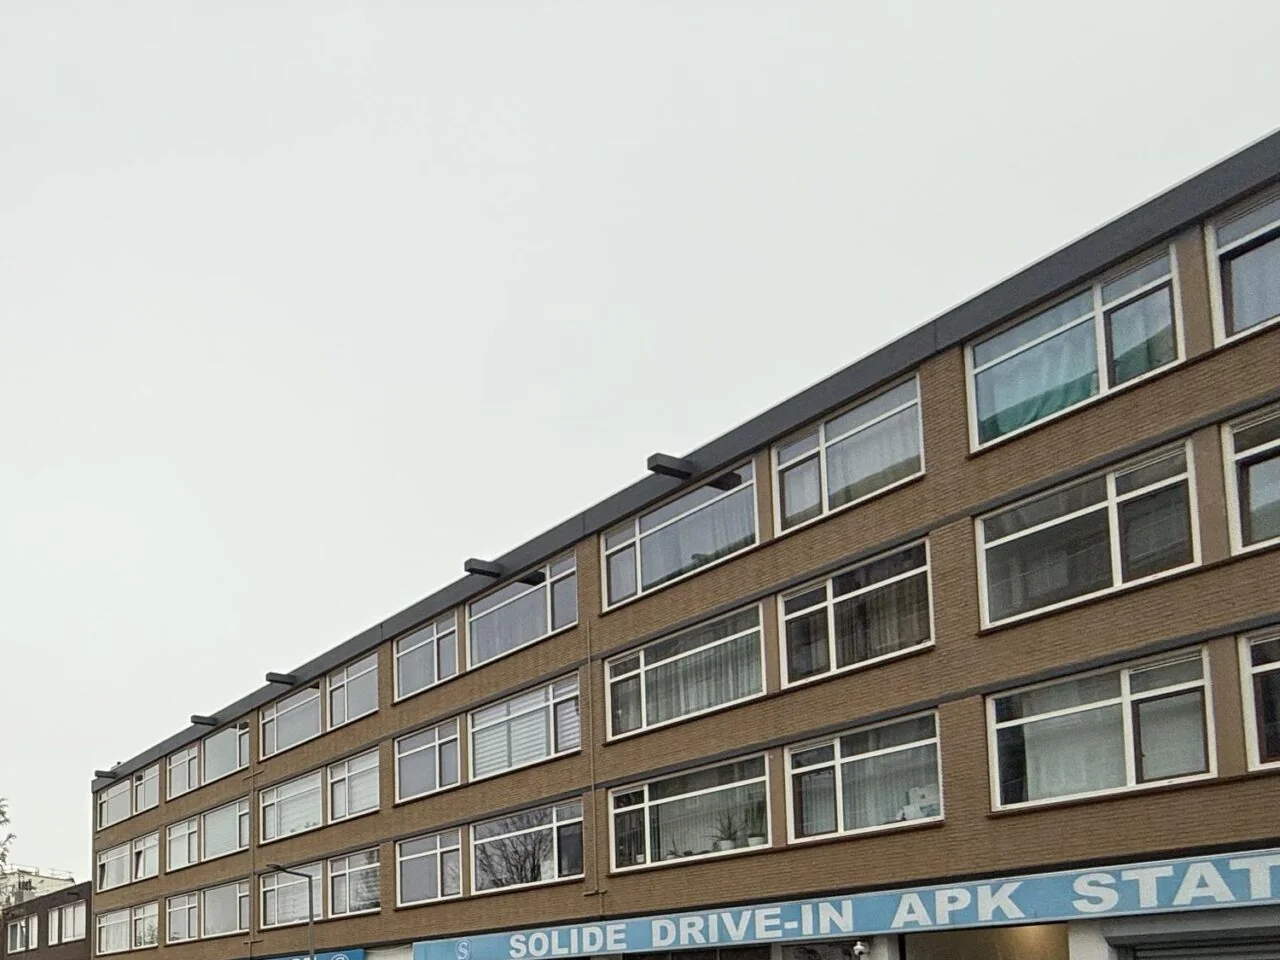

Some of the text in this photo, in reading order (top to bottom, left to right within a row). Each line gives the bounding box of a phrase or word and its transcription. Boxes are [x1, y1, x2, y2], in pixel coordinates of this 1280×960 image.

[509, 855, 1280, 958] SOLIDE DRIVE-IN APK STAT
